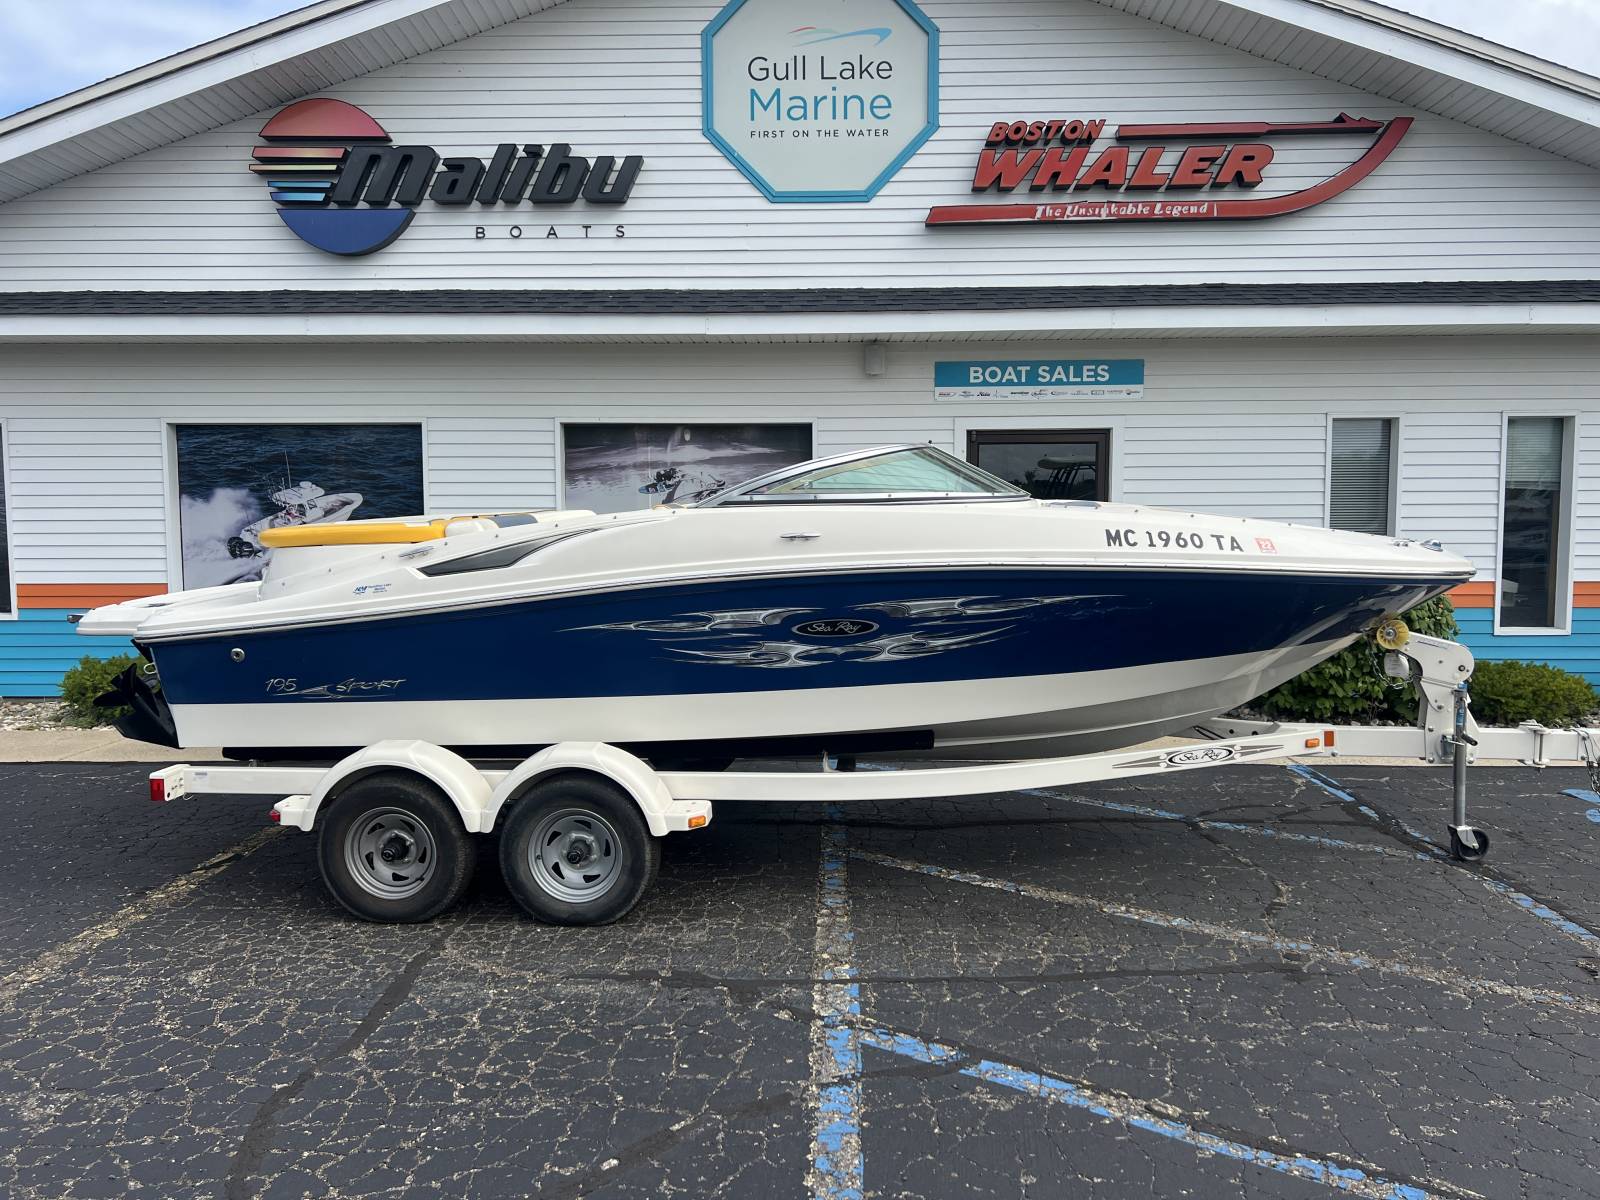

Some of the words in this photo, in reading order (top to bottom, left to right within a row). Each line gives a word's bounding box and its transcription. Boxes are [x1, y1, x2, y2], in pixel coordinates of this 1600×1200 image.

[748, 55, 806, 81] Gull
[820, 54, 893, 80] Lake
[750, 87, 892, 122] Marine
[751, 130, 785, 139] FIRST
[792, 129, 809, 138] ON
[816, 129, 840, 138] THE
[846, 128, 890, 138] WATER
[985, 119, 1107, 147] BOSTON
[331, 143, 644, 206] Malibu
[972, 143, 1275, 192] WHALER
[1035, 205, 1061, 220] The
[1153, 202, 1208, 217] Legend
[476, 225, 625, 239] BOATS
[969, 366, 1031, 384] BOAT
[1037, 365, 1110, 383] SALES
[1105, 528, 1138, 547] MC
[1146, 530, 1204, 550] 1960
[1210, 533, 1244, 553] TA
[807, 623, 832, 632] Sea
[835, 622, 861, 633] Ray
[266, 678, 296, 692] 195
[1179, 753, 1199, 761] Sea
[1201, 750, 1222, 760] Ray
